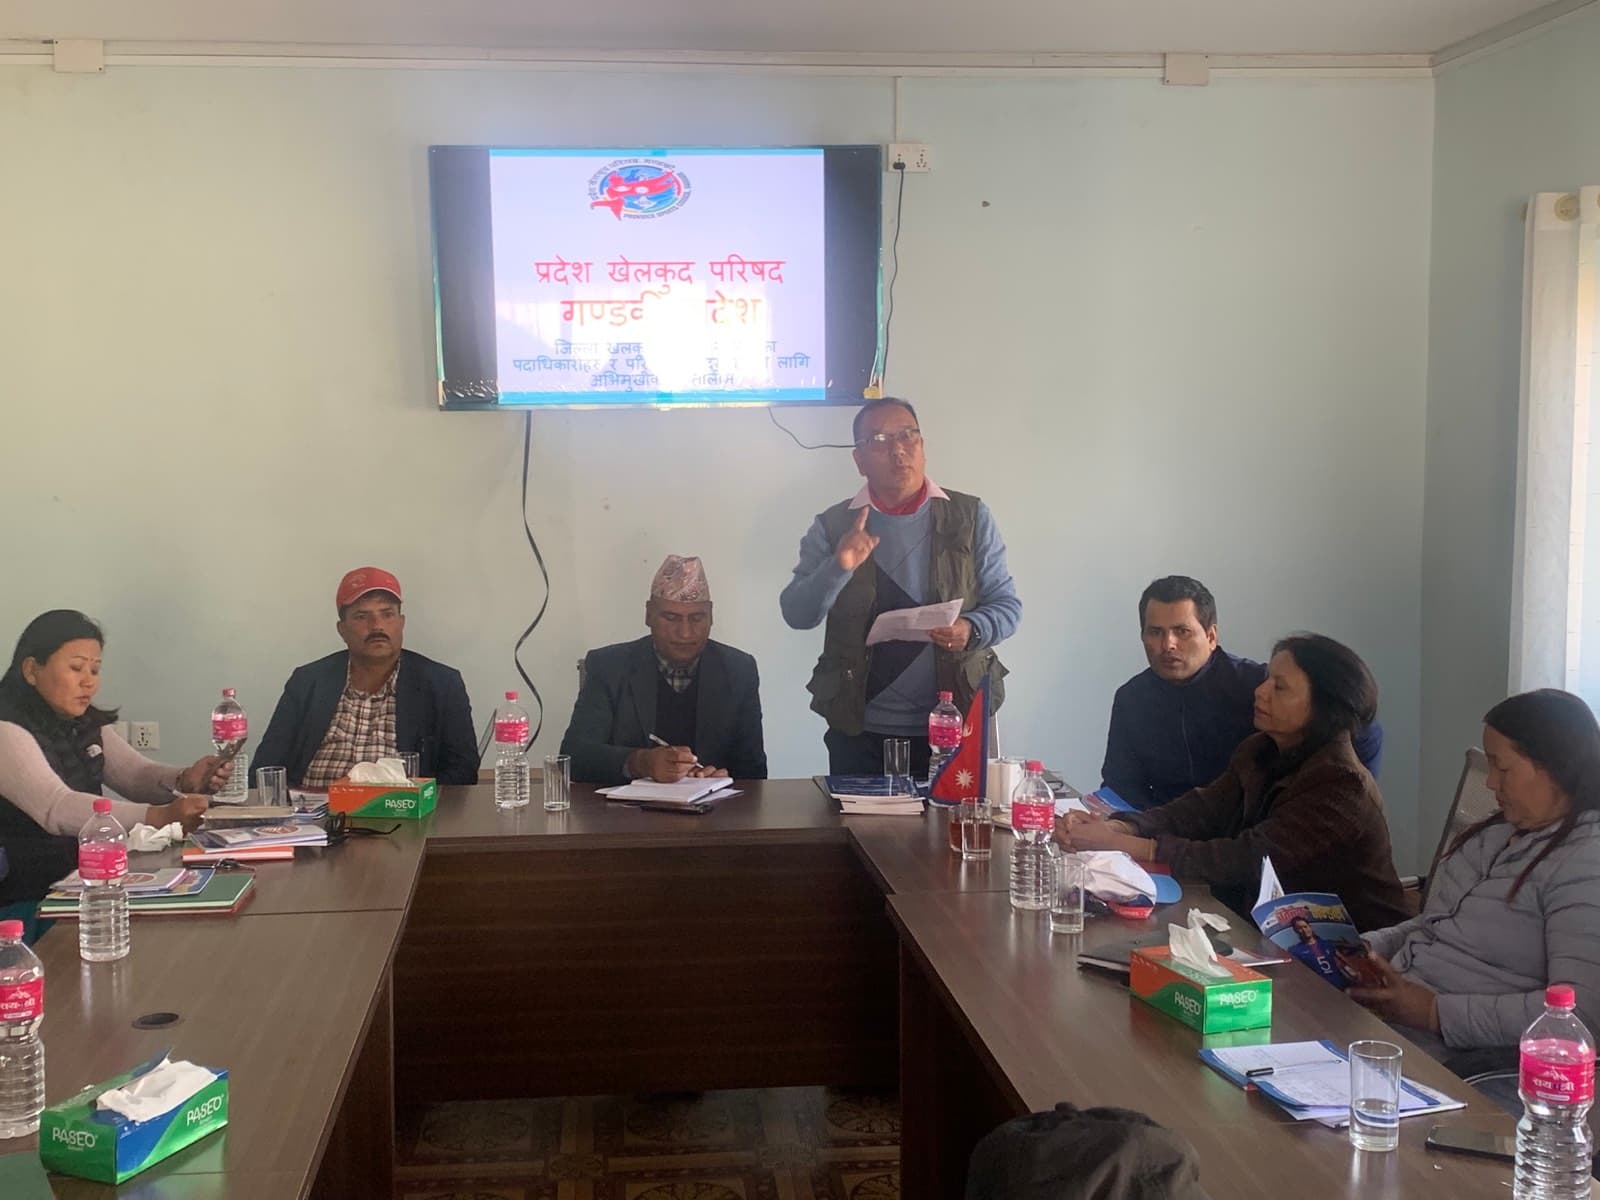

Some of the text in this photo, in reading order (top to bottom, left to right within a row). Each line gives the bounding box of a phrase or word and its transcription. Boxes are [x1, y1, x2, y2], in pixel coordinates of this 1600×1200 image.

[534, 253, 787, 295] प्रदेश खेलकुद परिषद
[776, 351, 811, 369] लागि
[384, 799, 416, 809] PASEO
[1174, 991, 1200, 1016] PASEO
[1219, 989, 1257, 1007] PASEO
[187, 1096, 222, 1127] PASEO
[52, 1127, 96, 1149] PASEO
